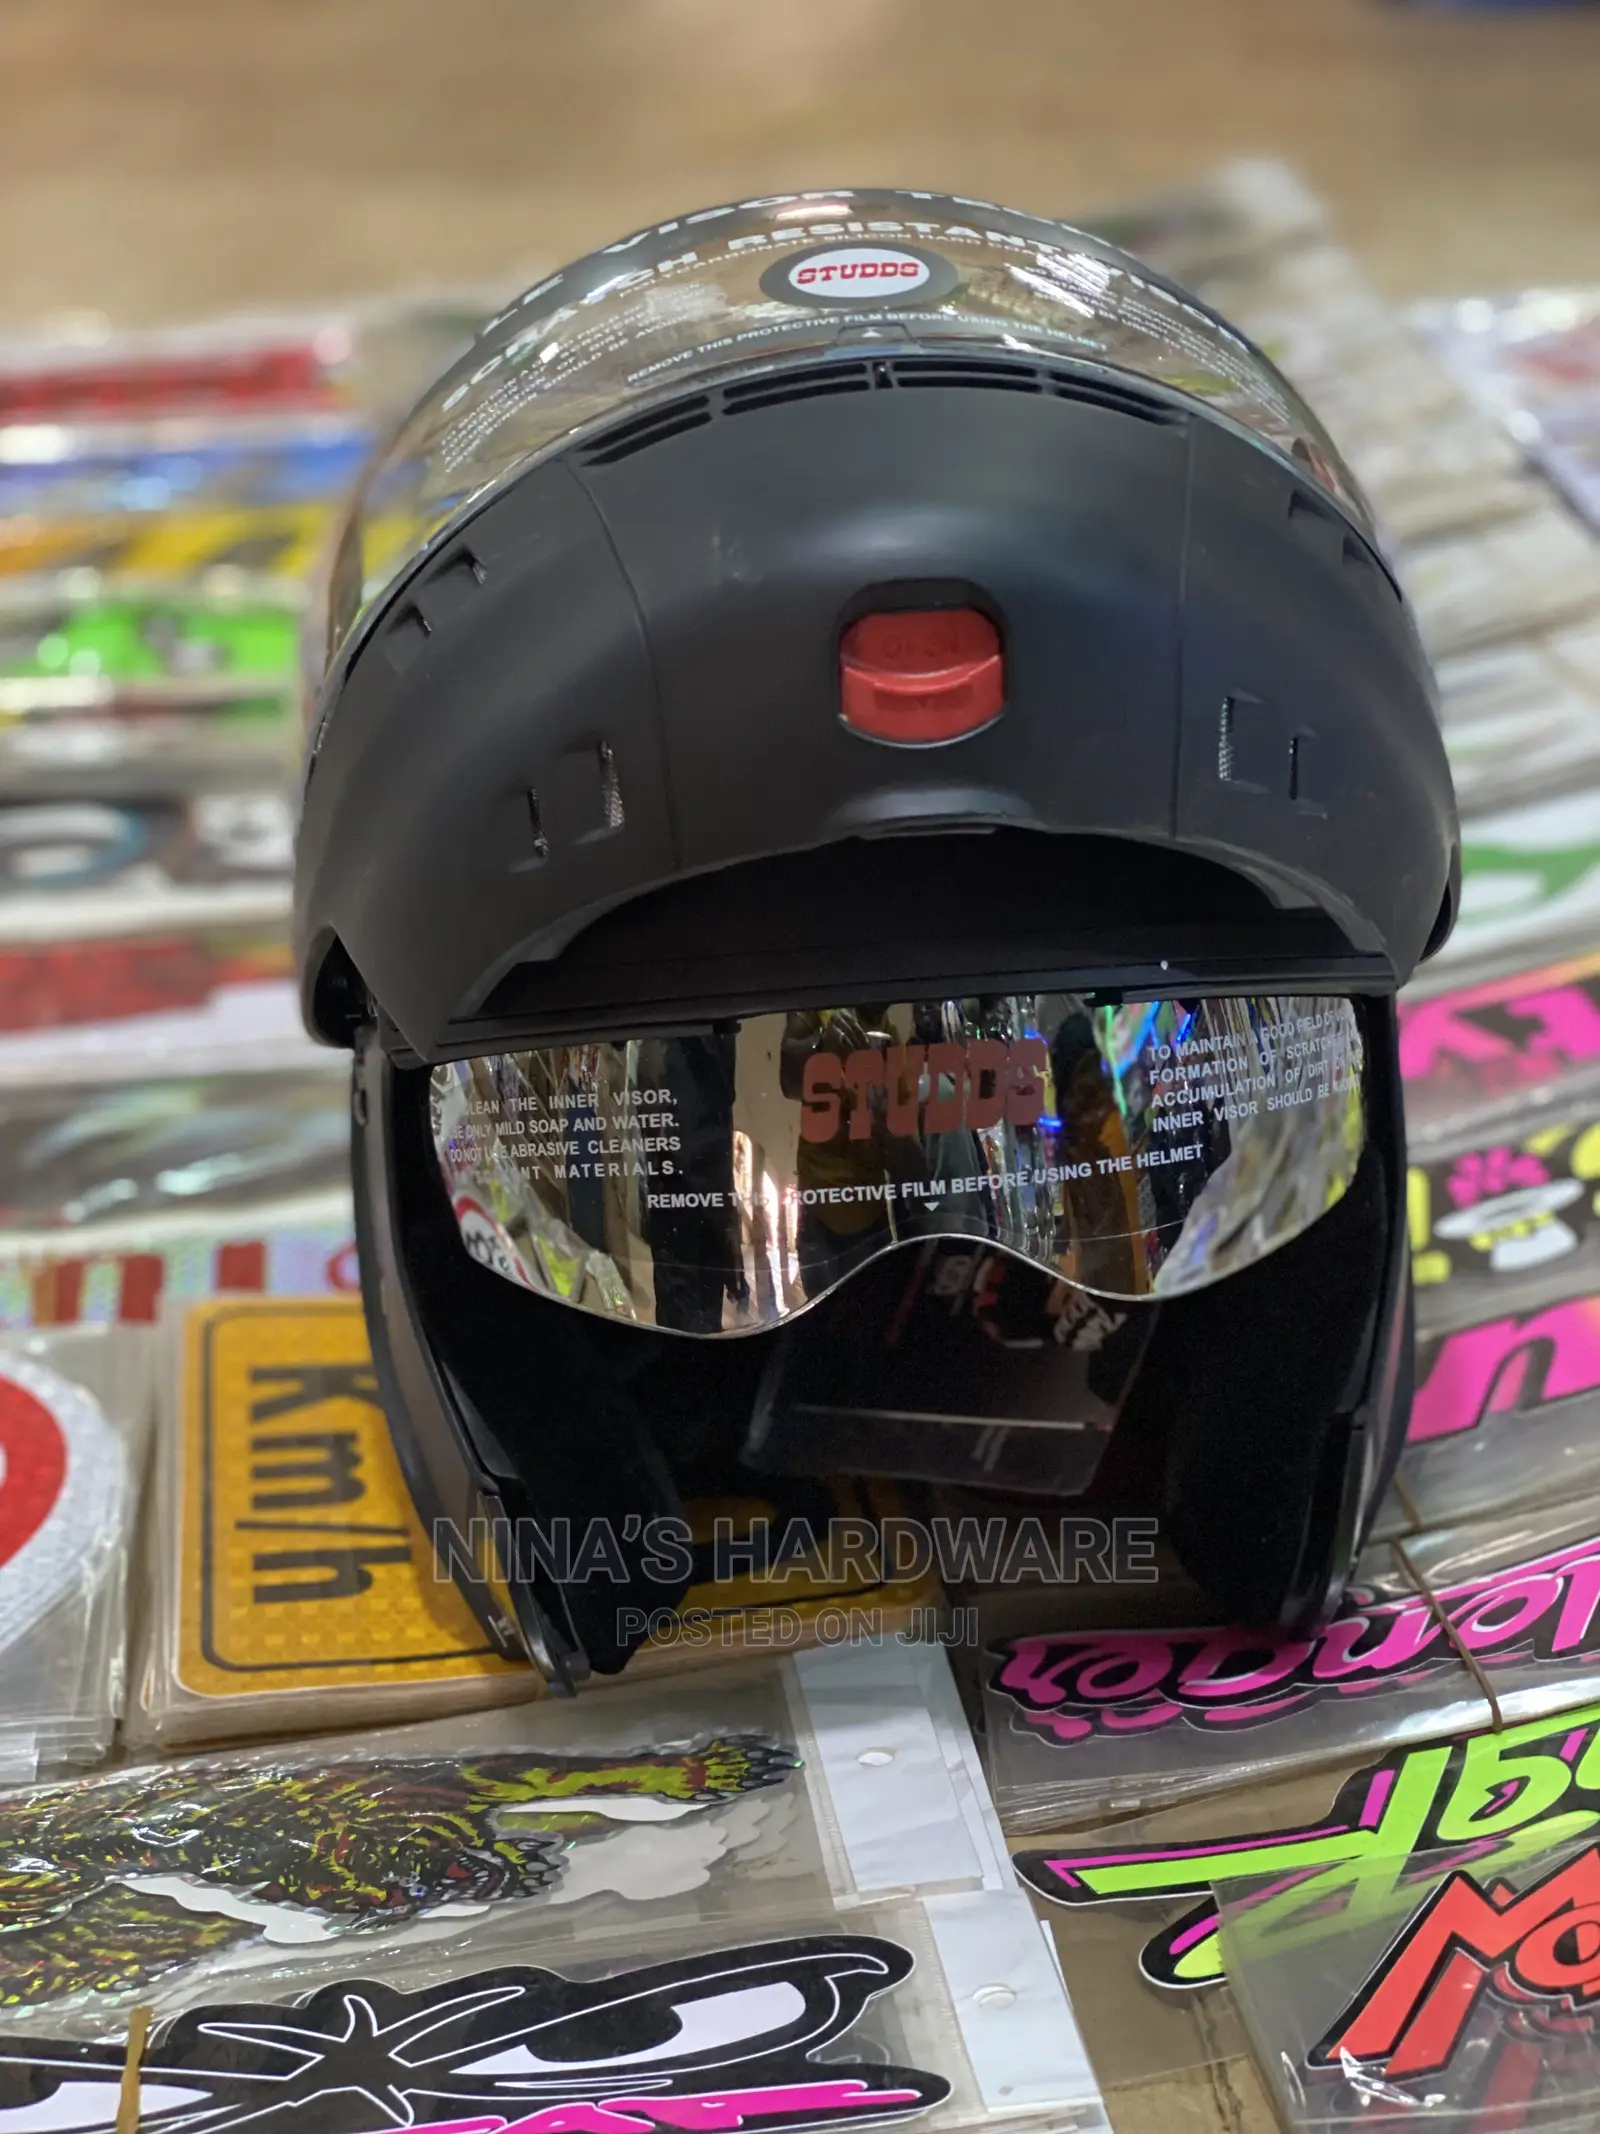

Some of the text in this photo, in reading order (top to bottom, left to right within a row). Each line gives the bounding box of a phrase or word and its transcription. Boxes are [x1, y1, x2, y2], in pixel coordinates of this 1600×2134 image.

[727, 220, 1063, 255] RESISTANT
[796, 262, 919, 285] STUDDS
[627, 312, 1108, 383] REMOVE THIS PROTECTIVE FILM BEFORE USING THE HELMET
[1147, 1044, 1172, 1062] TO
[1175, 1035, 1245, 1058] MAINTAIN
[1260, 1022, 1295, 1041] GOOD
[1149, 1056, 1248, 1085] FORMATION
[1259, 1050, 1277, 1067] OF
[1151, 1073, 1276, 1109] ACCUMULATION
[1284, 1067, 1301, 1084] OF
[1307, 1060, 1329, 1079] DIRT
[509, 1096, 538, 1111] THE
[549, 1093, 599, 1109] INNER
[614, 1089, 678, 1107] VISOR,
[800, 1038, 1047, 1143] STUDDS
[1152, 1110, 1204, 1133] INNER
[1214, 1101, 1259, 1123] VISOR
[1267, 1087, 1313, 1112] SHOULD
[1317, 1081, 1331, 1100] BE
[495, 1120, 525, 1136] MILD
[529, 1118, 569, 1134] SOAP
[573, 1117, 607, 1132] AND
[612, 1112, 679, 1130] WATER.
[510, 1140, 580, 1158] ABRASIVE
[587, 1136, 681, 1154] CLEANERS
[554, 1161, 684, 1179] MATERIALS.
[648, 1192, 724, 1209] REMOVE
[901, 1179, 946, 1198] FILM
[951, 1172, 1028, 1195] BEFORE
[1034, 1162, 1092, 1185] USING
[1096, 1155, 1132, 1174] THE
[1136, 1144, 1204, 1169] HELMET
